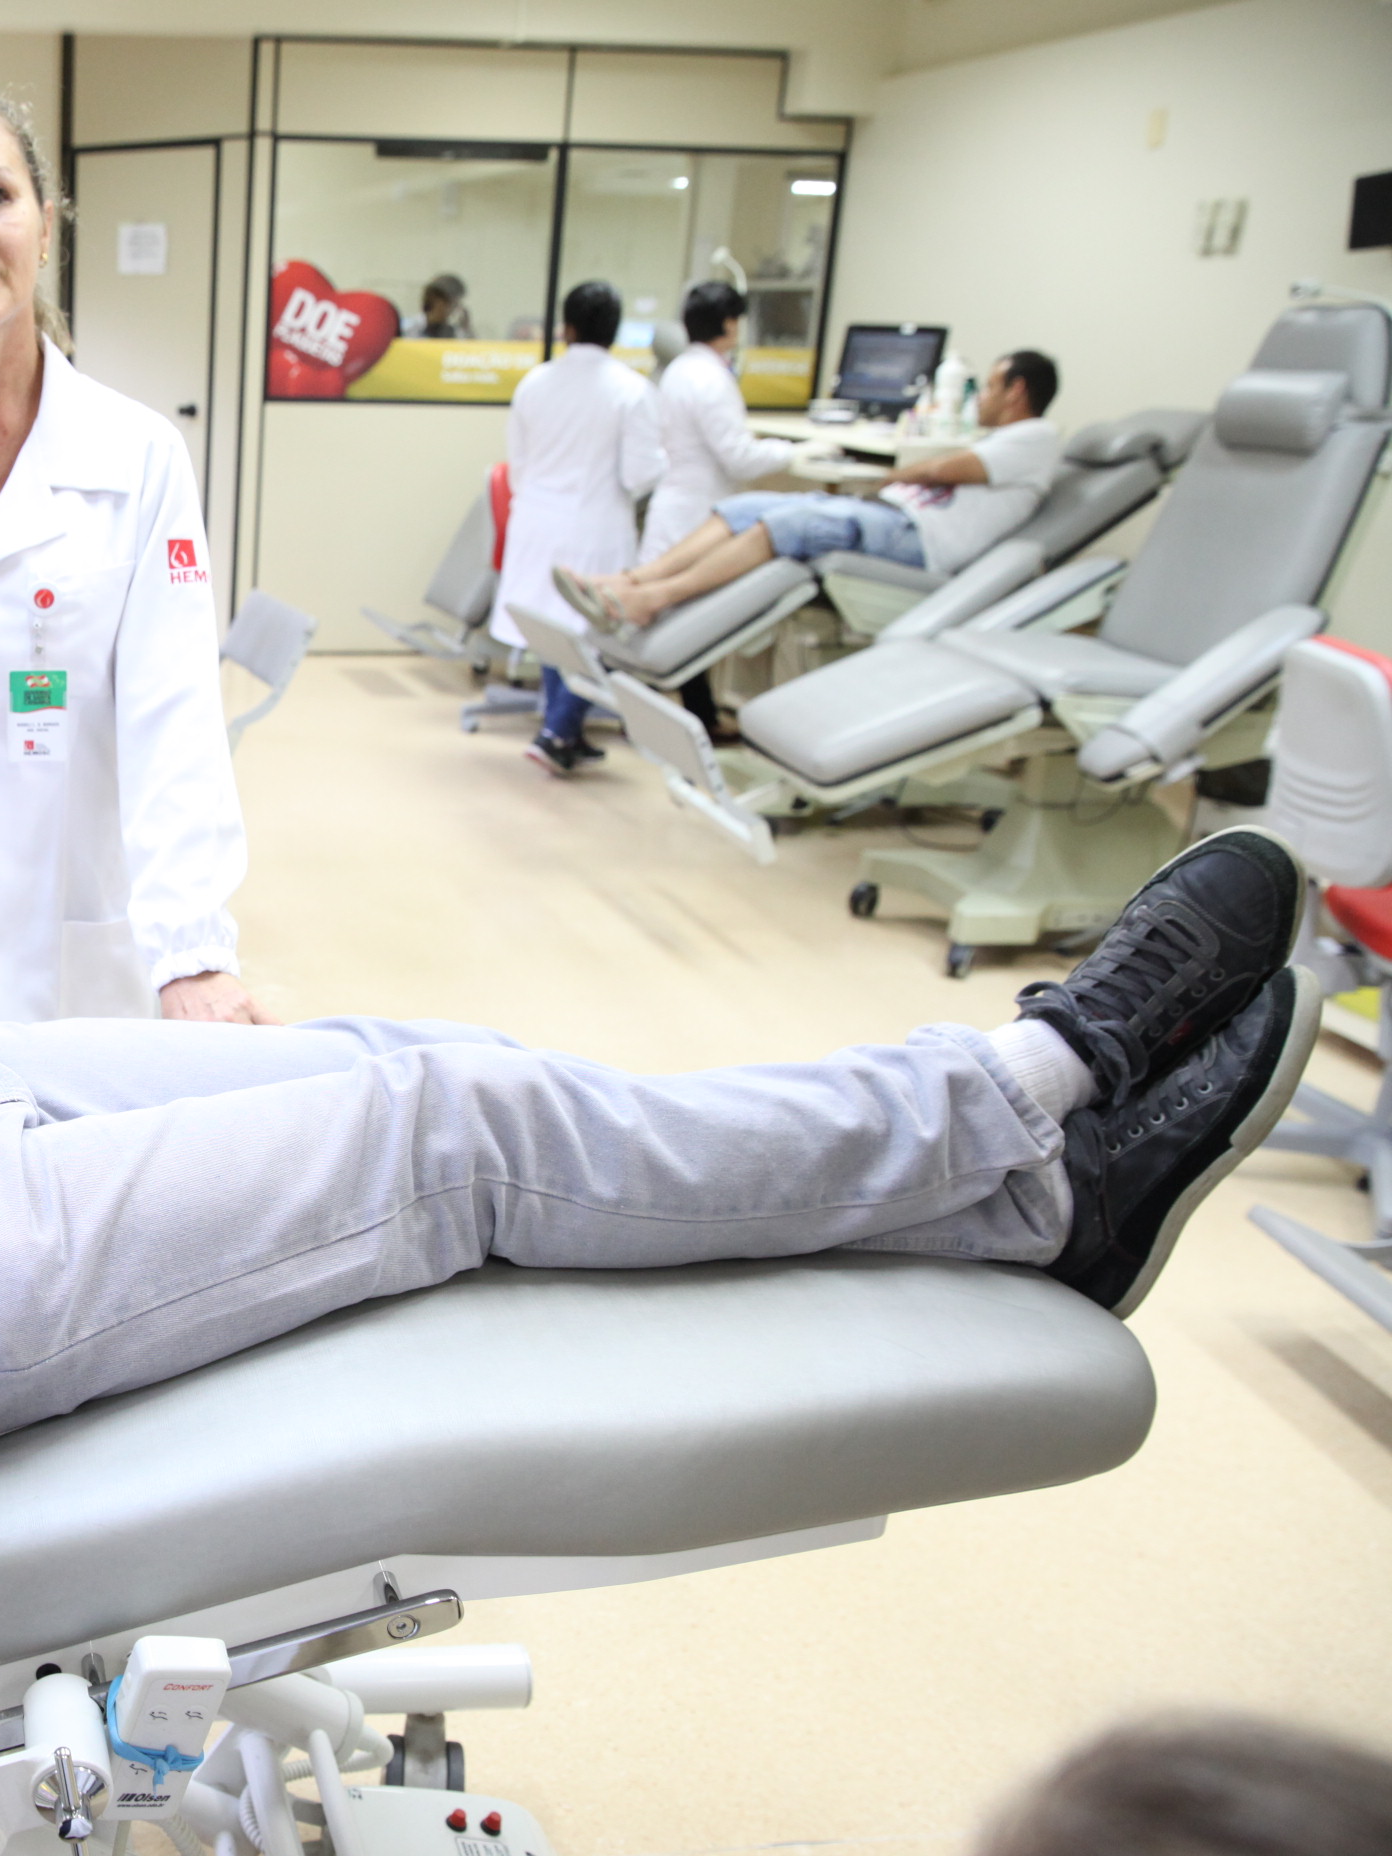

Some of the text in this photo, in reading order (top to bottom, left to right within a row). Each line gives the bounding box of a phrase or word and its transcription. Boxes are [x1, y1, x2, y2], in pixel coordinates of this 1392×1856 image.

[278, 287, 360, 348] DOE
[170, 570, 210, 584] HEM
[134, 1793, 170, 1802] Olsen
